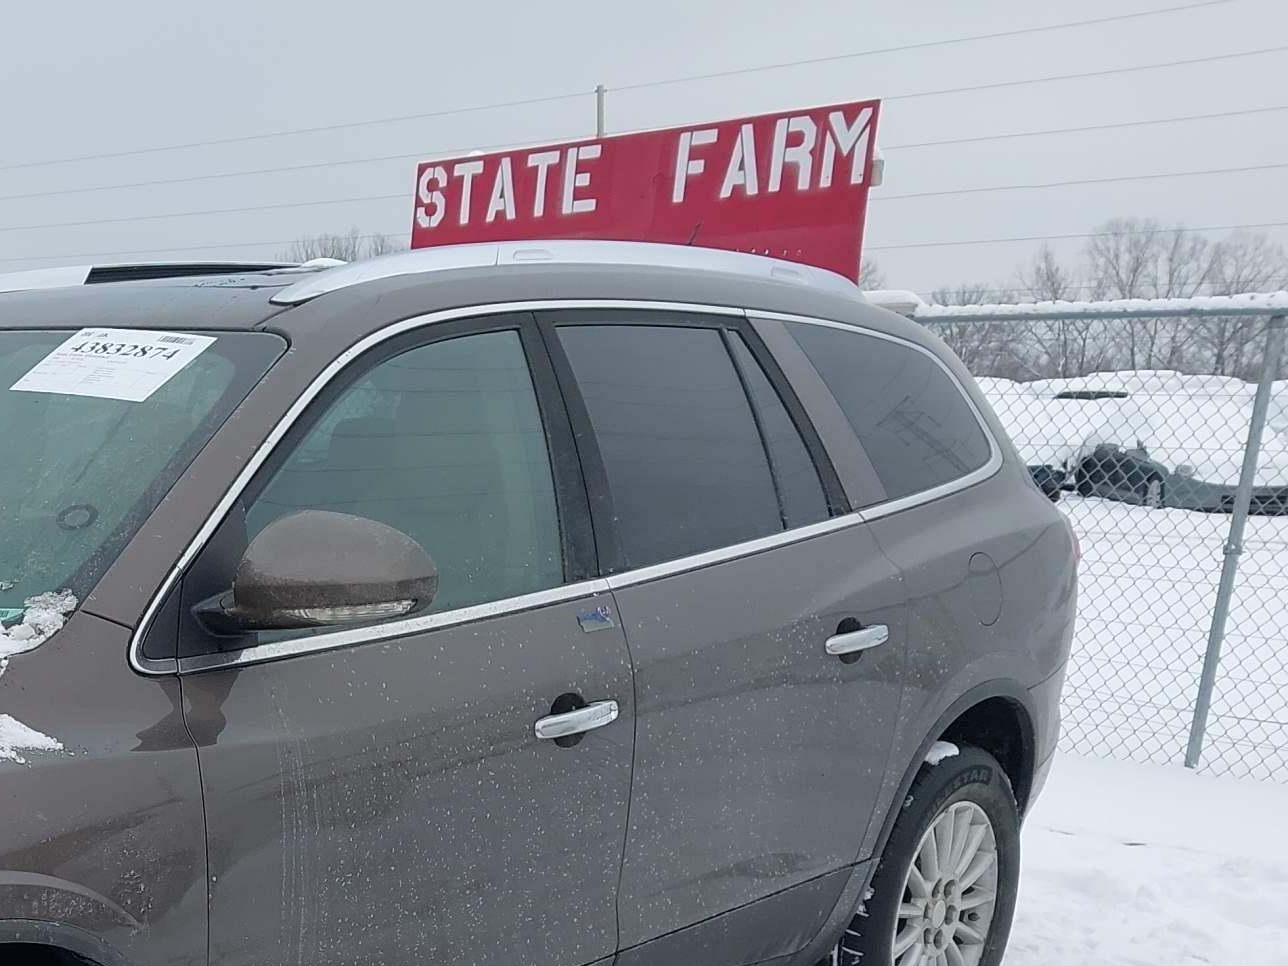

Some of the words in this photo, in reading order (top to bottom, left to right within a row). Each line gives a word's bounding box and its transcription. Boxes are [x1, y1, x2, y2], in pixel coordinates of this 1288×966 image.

[416, 145, 602, 228] STATE
[673, 107, 873, 203] FARM
[71, 340, 181, 361] 43832874
